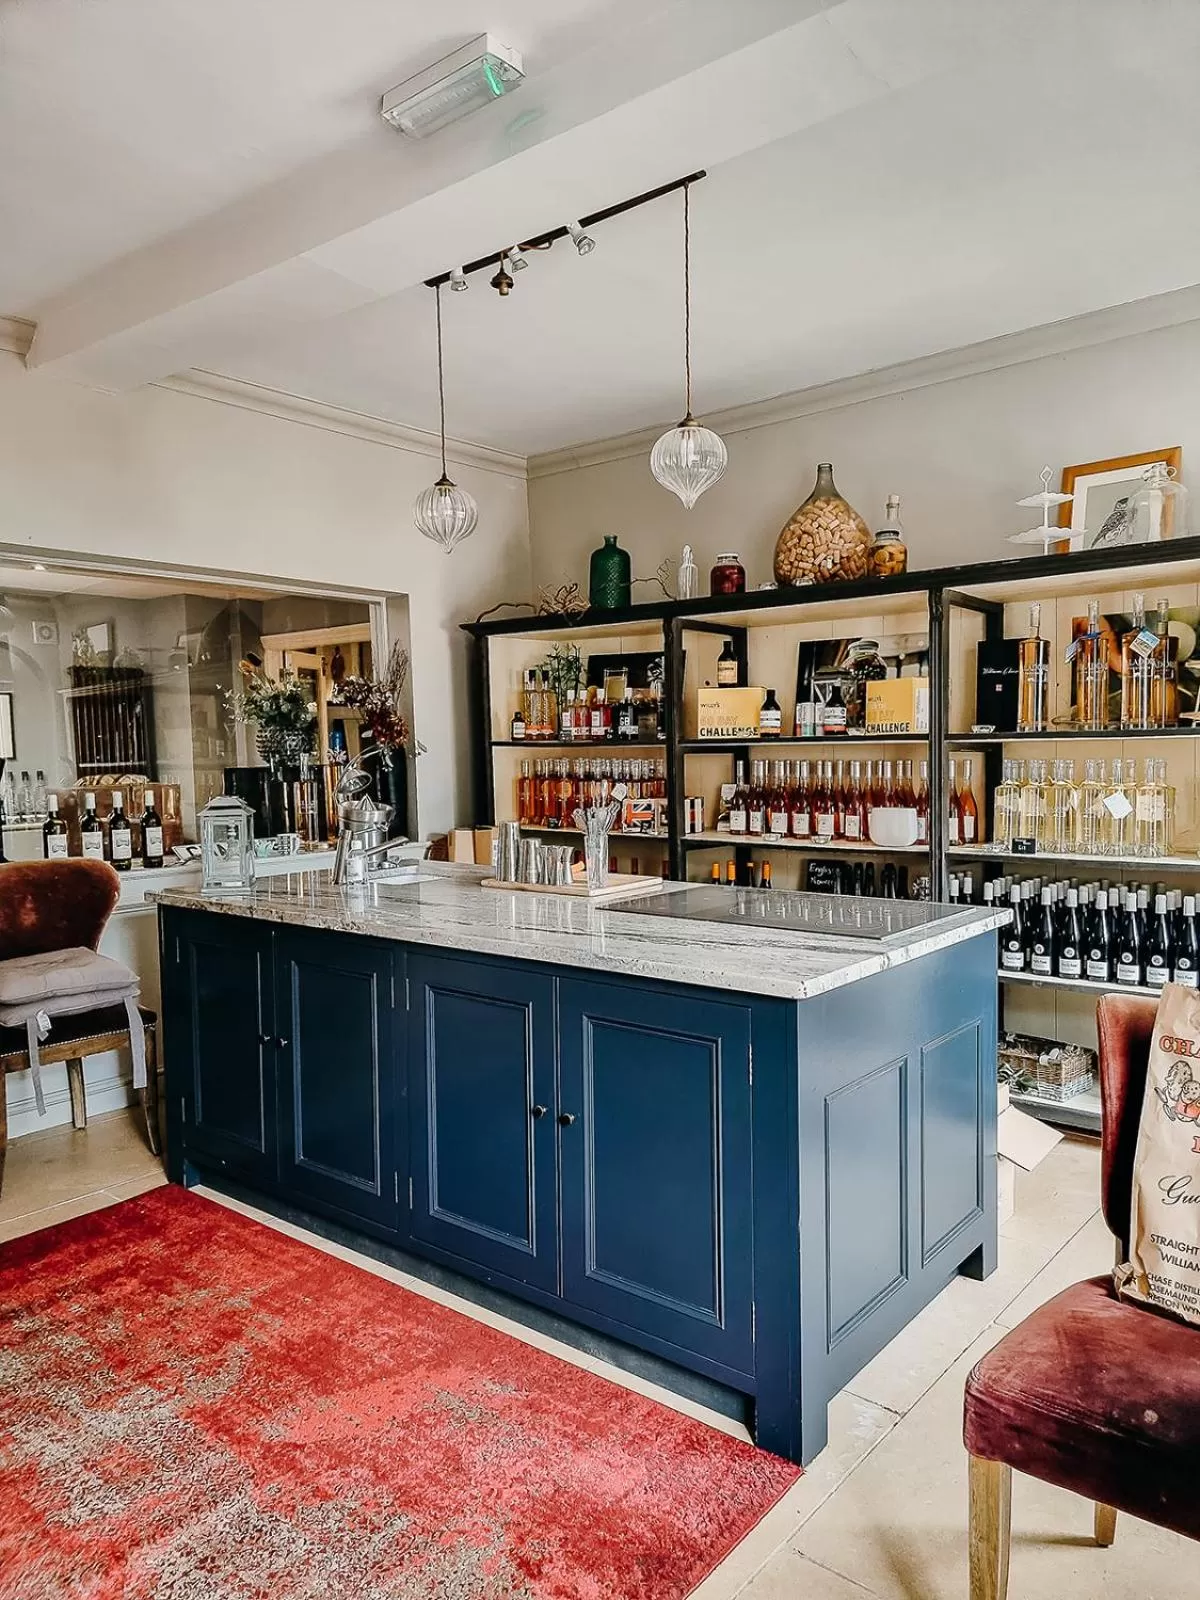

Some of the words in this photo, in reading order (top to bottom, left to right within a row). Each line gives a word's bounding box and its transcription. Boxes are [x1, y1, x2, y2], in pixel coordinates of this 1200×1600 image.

[700, 727, 759, 736] CHALLENGE
[867, 722, 910, 733] CHALLENGE
[1150, 1233, 1200, 1256] STRAIGHT
[1149, 1283, 1198, 1305] OSEMAUND
